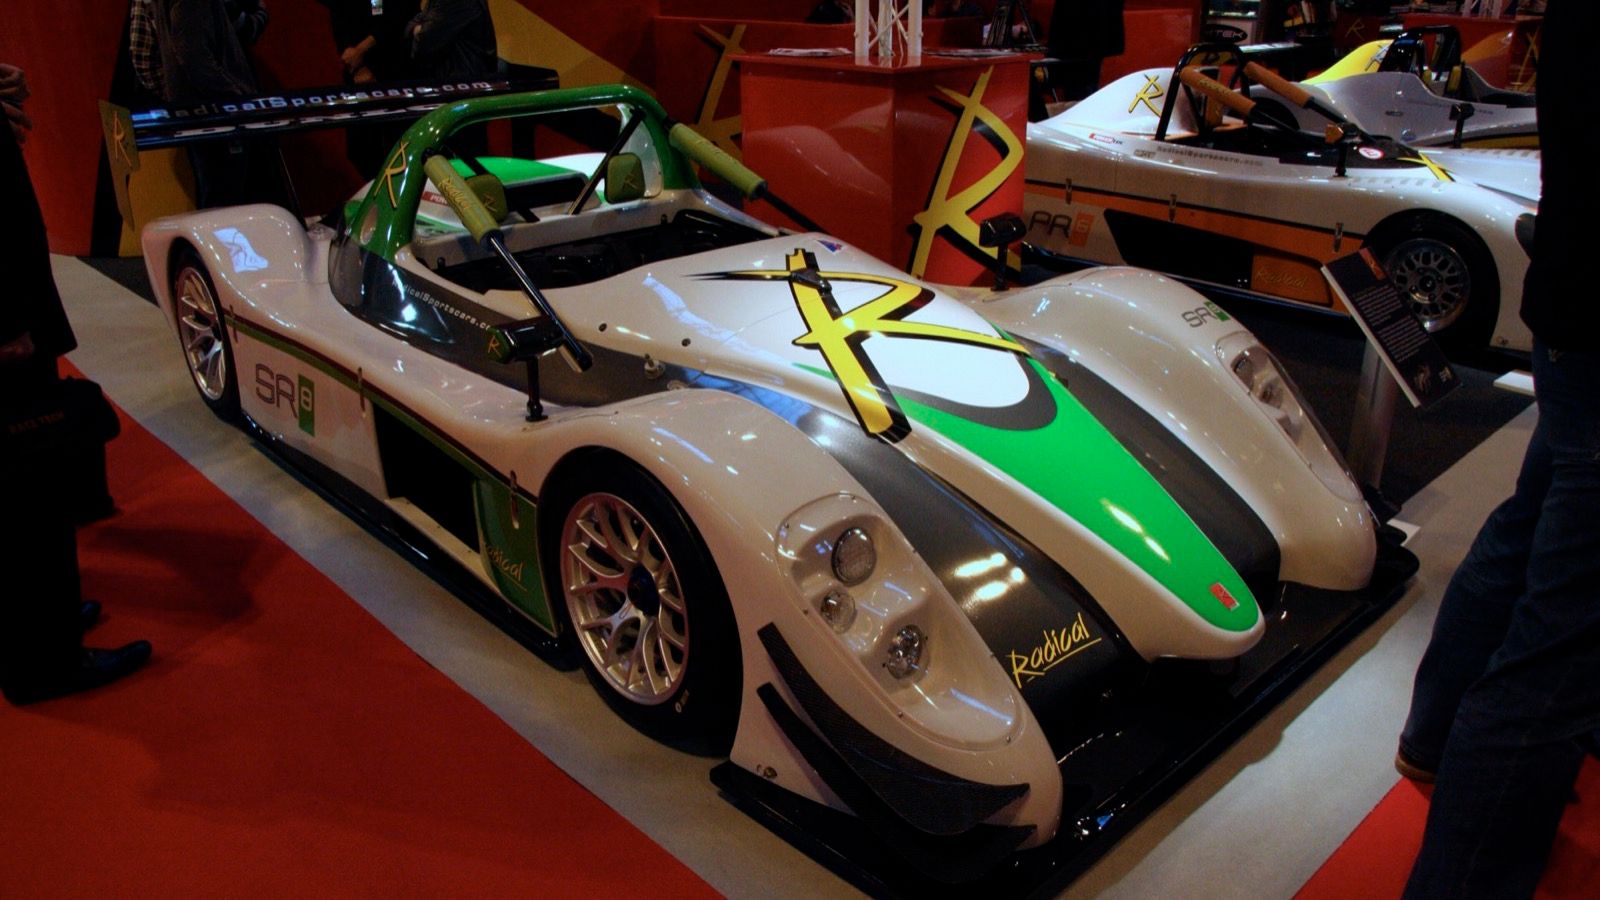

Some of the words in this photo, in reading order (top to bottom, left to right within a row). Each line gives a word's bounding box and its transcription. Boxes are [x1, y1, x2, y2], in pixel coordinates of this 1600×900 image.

[373, 141, 410, 209] R
[255, 363, 313, 419] SR8
[487, 545, 526, 592] adical
[1005, 611, 1102, 689] Radical
